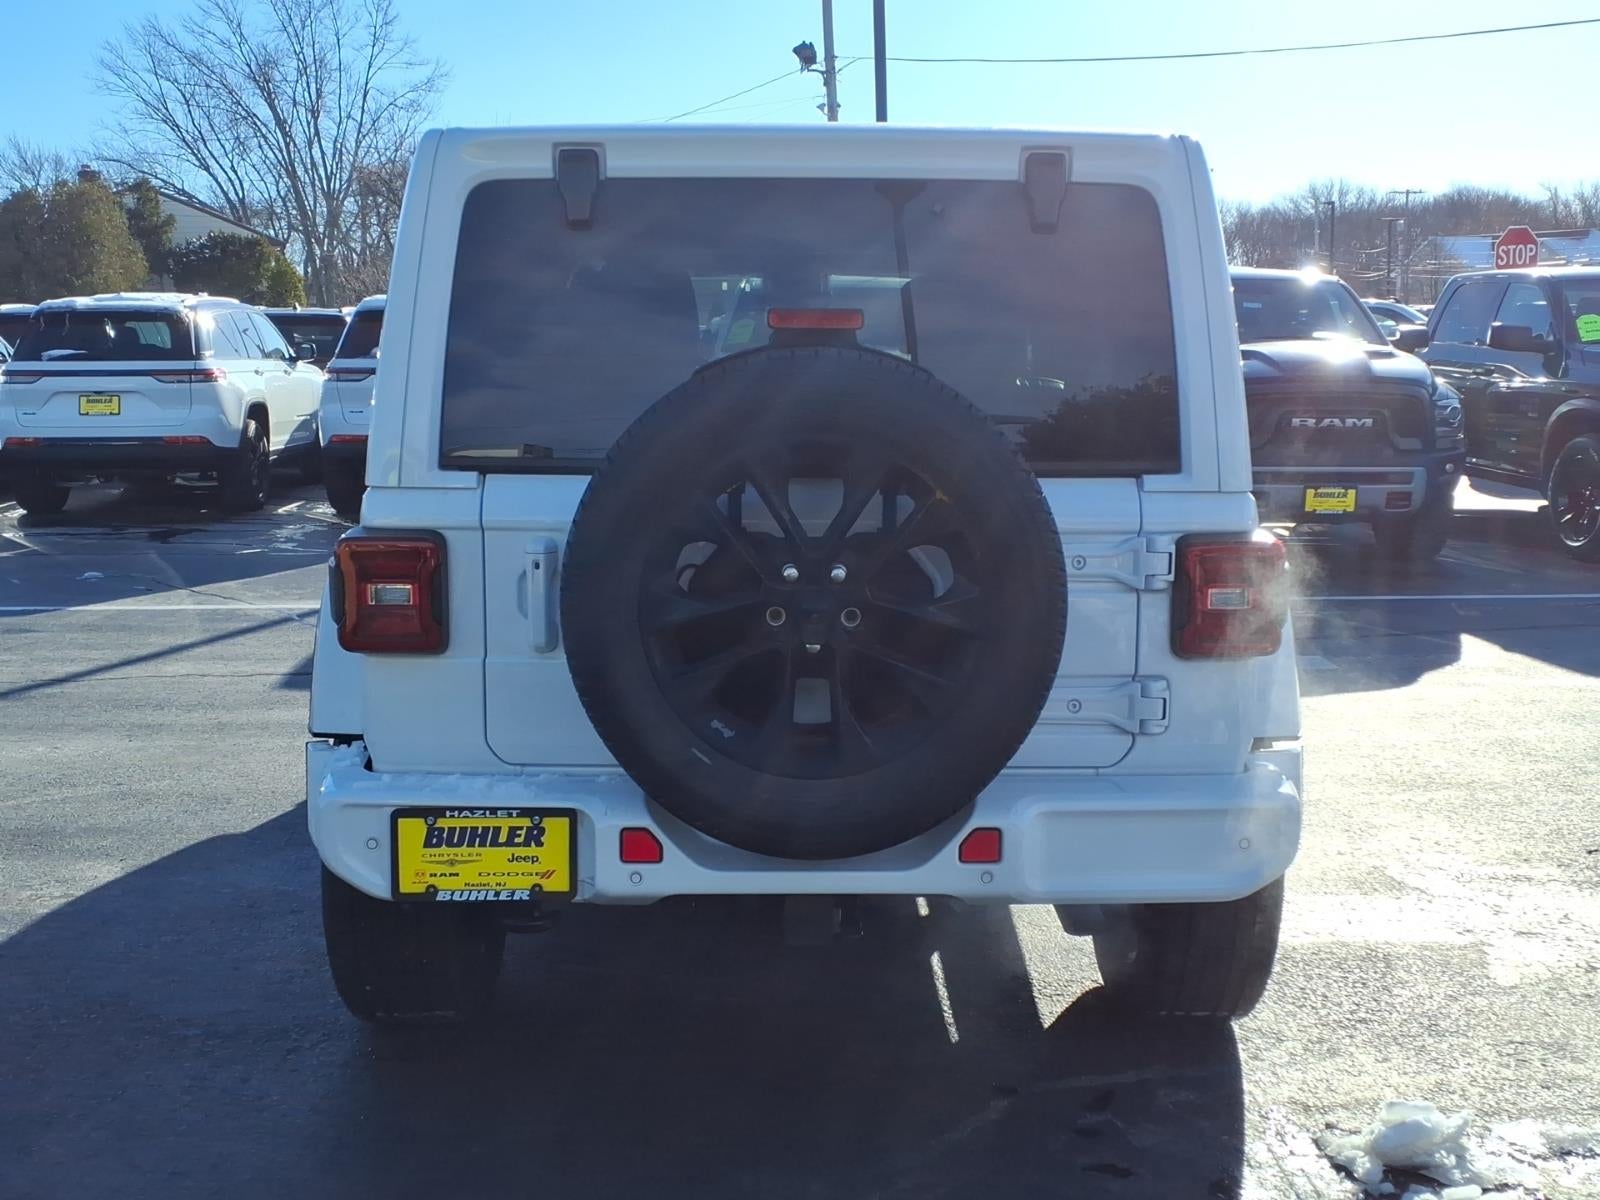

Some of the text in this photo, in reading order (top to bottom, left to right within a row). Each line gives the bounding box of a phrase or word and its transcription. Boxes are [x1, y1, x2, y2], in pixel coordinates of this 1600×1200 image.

[1498, 245, 1536, 265] STOP
[1291, 418, 1373, 428] RAM
[445, 809, 521, 818] HAZLET
[422, 825, 546, 849] BUHLER
[507, 853, 540, 865] Jeep
[435, 889, 531, 901] BUHLER
